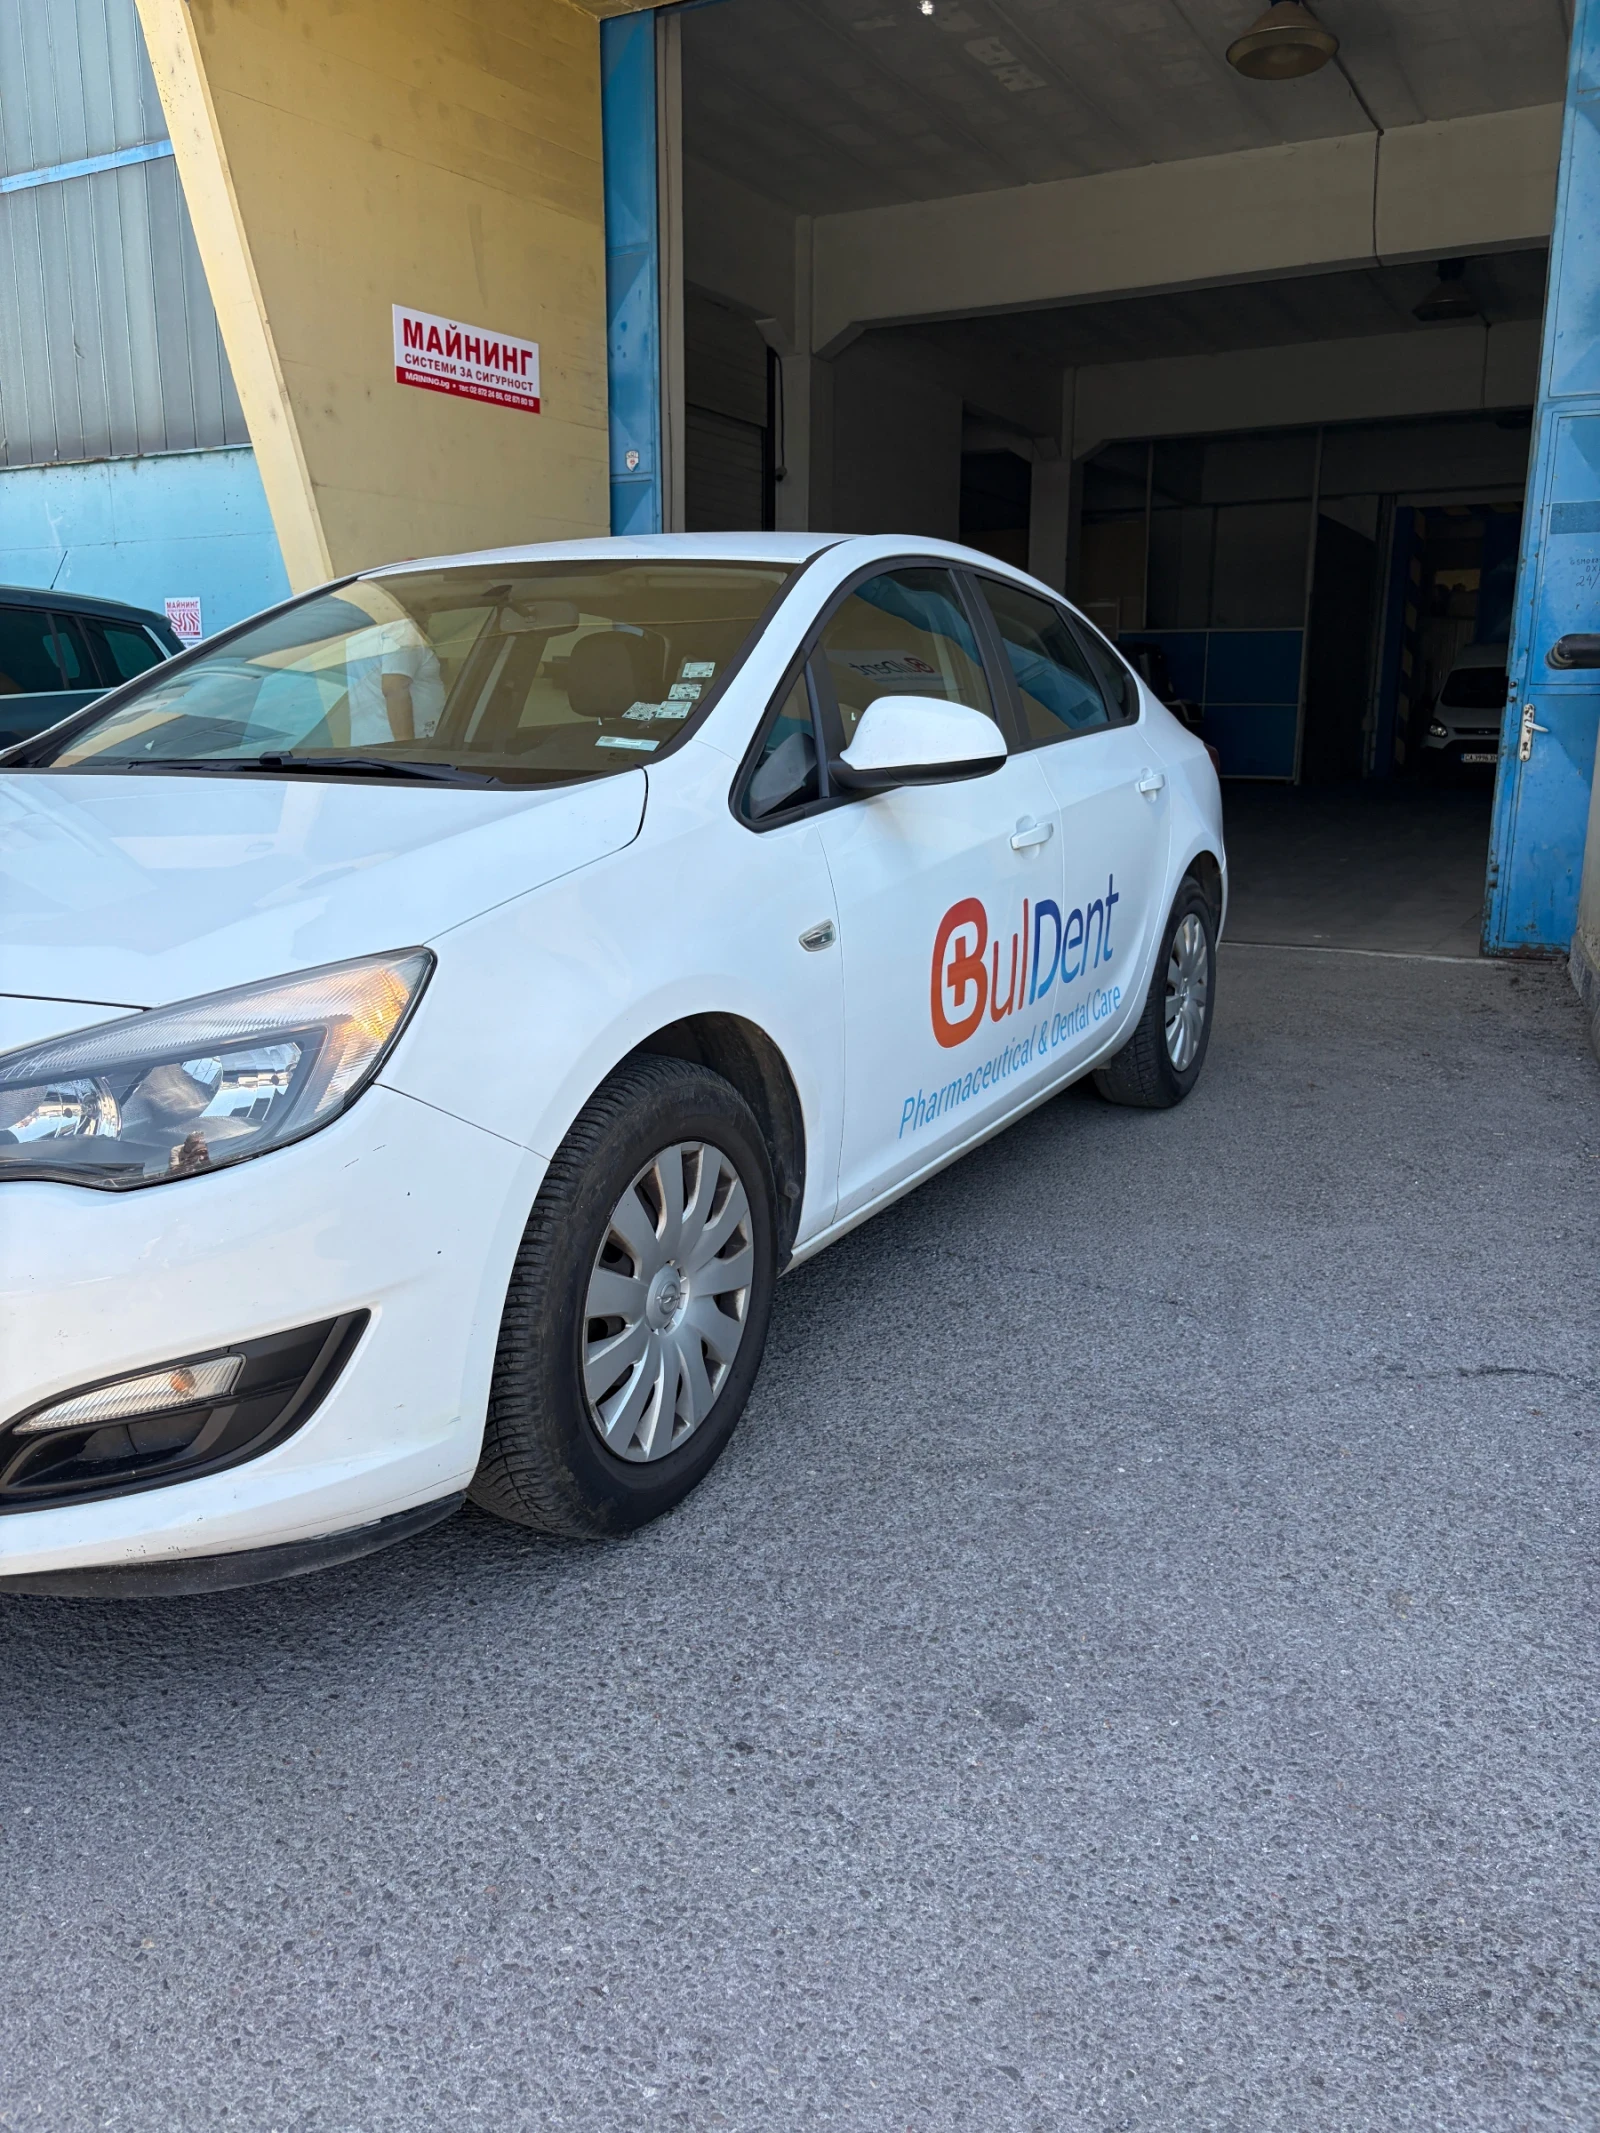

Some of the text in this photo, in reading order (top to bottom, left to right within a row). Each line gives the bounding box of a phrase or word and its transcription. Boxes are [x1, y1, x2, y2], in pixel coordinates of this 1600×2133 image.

[402, 318, 533, 376] МАЙНИНГ
[404, 353, 534, 392] СИСТЕМИ ЗА СИГУРНОСТ
[469, 385, 477, 394] 02
[166, 600, 199, 608] МАЙНИНГ
[930, 873, 1120, 1049] BulDent
[898, 985, 1121, 1139] Pharmaceutical & Dental Care
